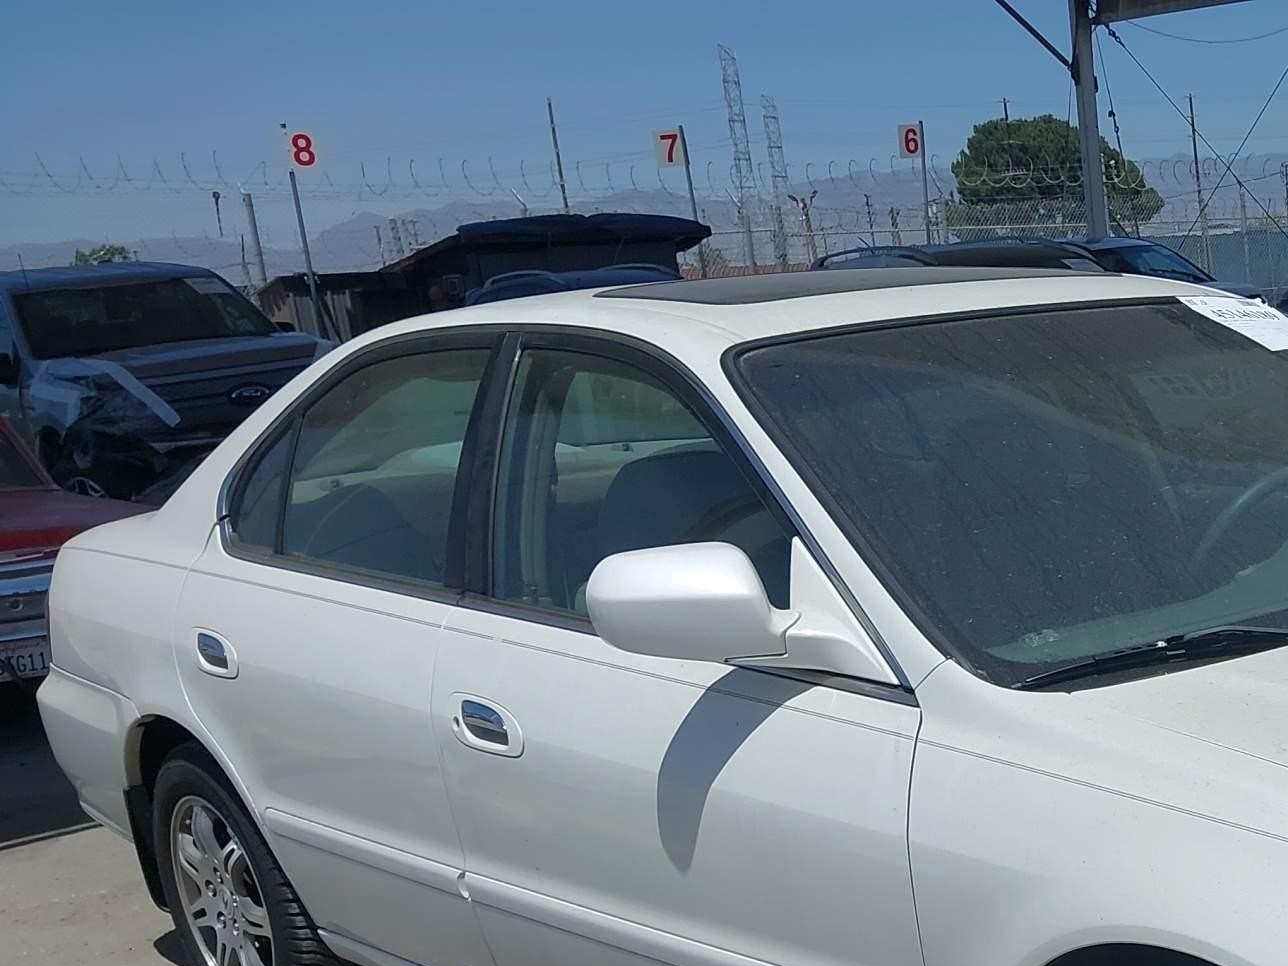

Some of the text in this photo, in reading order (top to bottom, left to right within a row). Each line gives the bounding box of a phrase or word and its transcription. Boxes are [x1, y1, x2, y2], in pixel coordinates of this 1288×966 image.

[291, 133, 316, 167] 8
[659, 133, 678, 163] 7
[904, 127, 919, 154] 6
